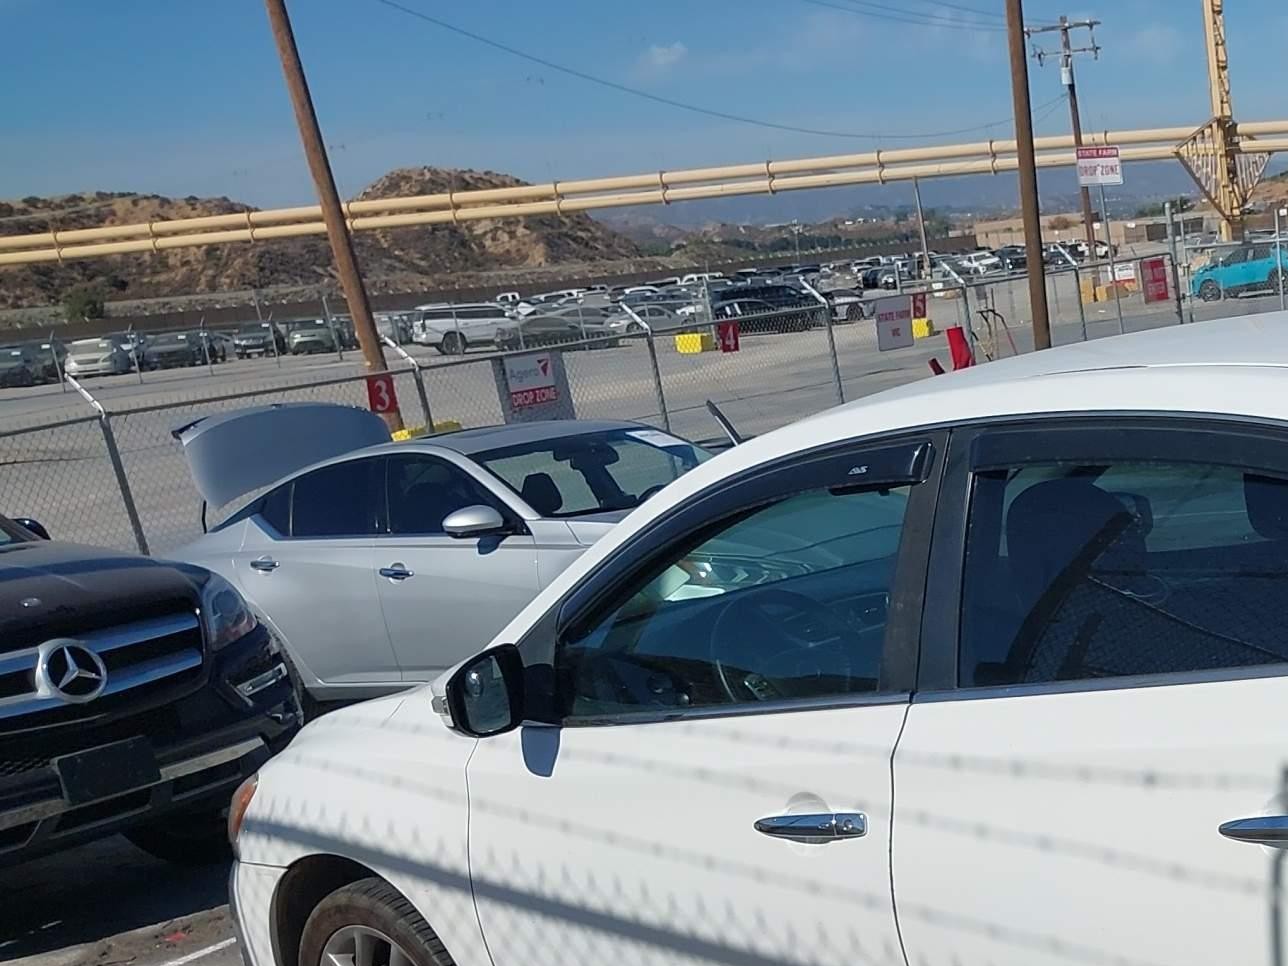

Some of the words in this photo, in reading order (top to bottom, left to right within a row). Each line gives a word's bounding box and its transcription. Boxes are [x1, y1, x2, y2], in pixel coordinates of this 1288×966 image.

[1080, 165, 1097, 176] DROP
[1100, 164, 1119, 175] ZONE
[725, 325, 736, 350] 4
[374, 380, 390, 411] 3
[512, 390, 534, 407] DROP
[535, 386, 557, 402] ZONE
